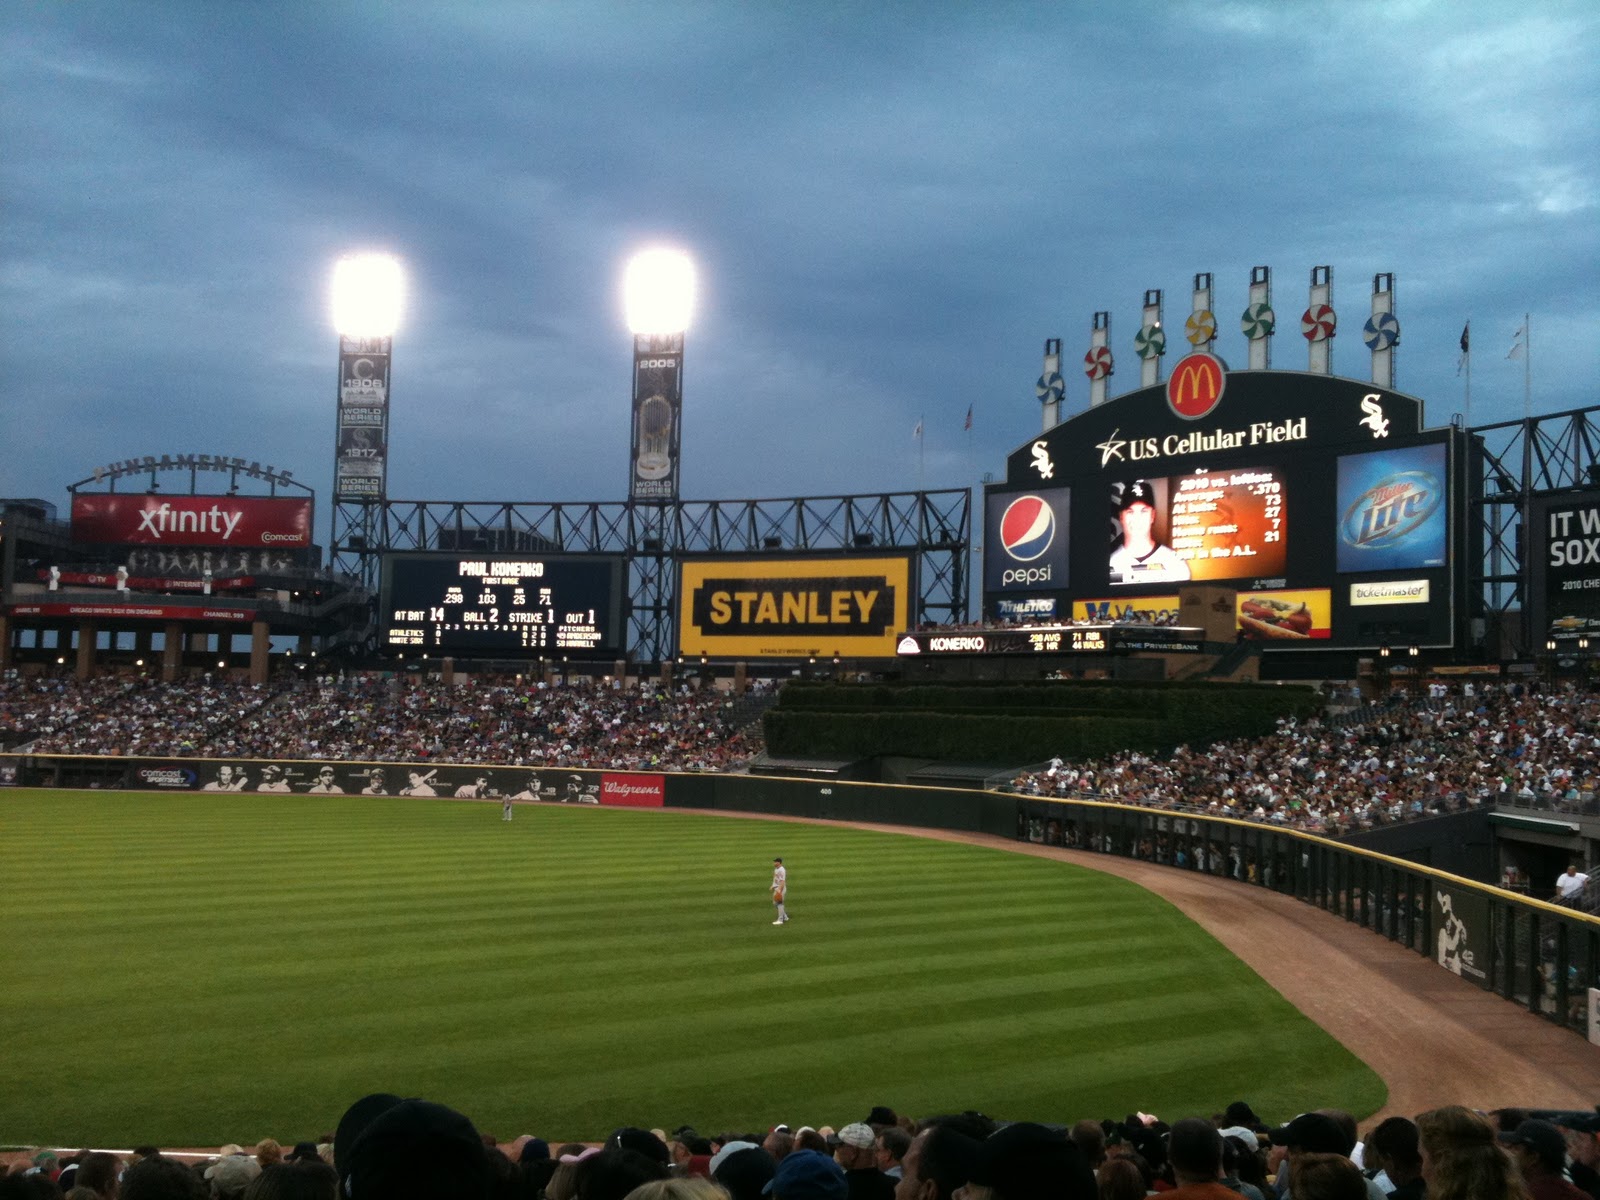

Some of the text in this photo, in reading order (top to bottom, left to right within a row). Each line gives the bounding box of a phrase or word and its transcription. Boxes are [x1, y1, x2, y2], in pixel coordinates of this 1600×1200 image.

[640, 359, 676, 368] 2005
[345, 379, 382, 388] 1906
[1130, 418, 1307, 461] U.S. Cellular Field
[346, 449, 377, 457] 1917
[94, 453, 293, 487] FUNDAMENTALS
[1265, 494, 1281, 505] 73
[1264, 506, 1281, 518] 27
[138, 503, 242, 539] xfinity
[1272, 518, 1281, 529] 7
[1551, 511, 1573, 538] IT
[1264, 531, 1279, 542] 21
[1550, 537, 1600, 567] SOX
[459, 561, 544, 577] PAUL KONERKO
[1003, 565, 1051, 586] pepsi
[1562, 580, 1582, 590] 2010
[1356, 587, 1424, 598] ticketmaster
[443, 594, 463, 604] .298
[478, 594, 496, 604] 103
[513, 595, 526, 605] 25
[539, 595, 552, 605] 71
[710, 590, 878, 625] STANLEY
[395, 607, 444, 621] AT BAT 14
[463, 608, 499, 623] BALL 2
[508, 609, 554, 624] STRIKE 1
[566, 609, 595, 624] OUT 1
[389, 629, 425, 637] ATHLETICS
[1044, 633, 1061, 642] AVG
[1072, 632, 1082, 641] 71
[930, 637, 984, 651] KONERKO
[1046, 642, 1058, 650] HR
[1072, 641, 1082, 649] 44
[604, 782, 660, 796] Walgreens
